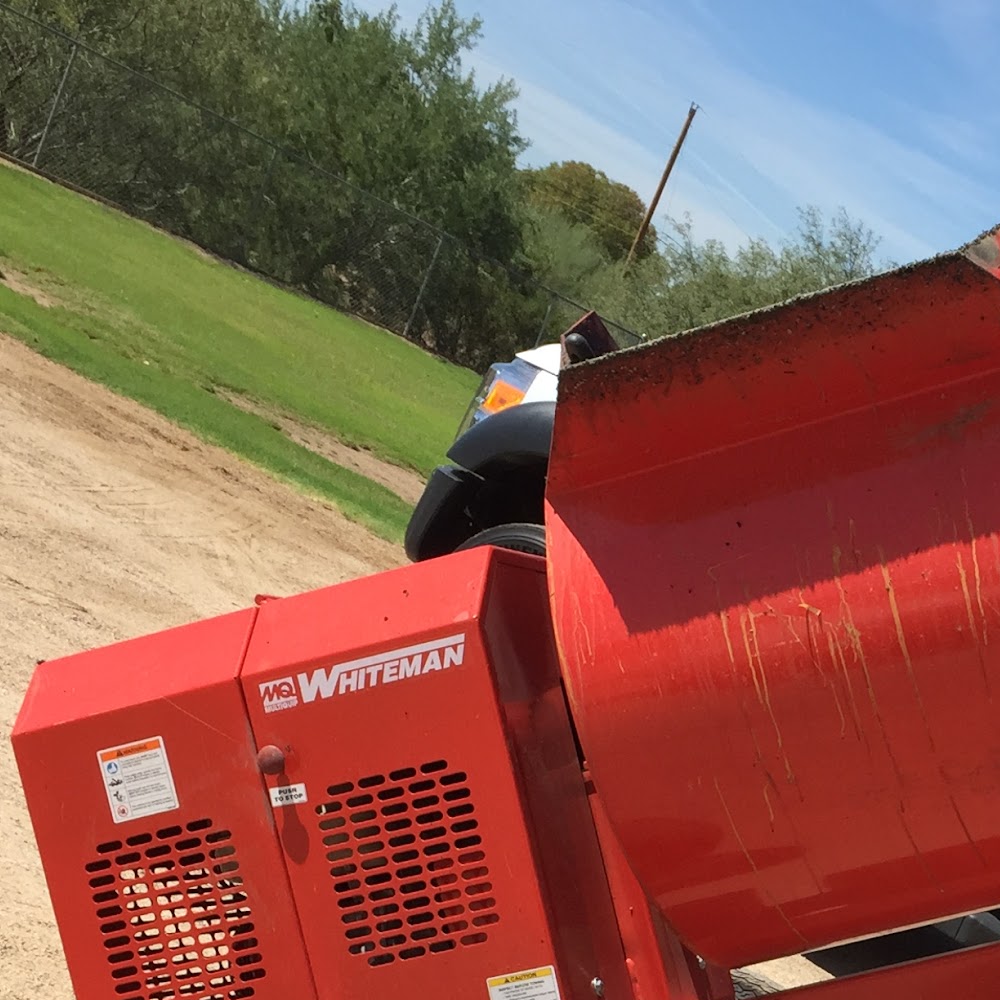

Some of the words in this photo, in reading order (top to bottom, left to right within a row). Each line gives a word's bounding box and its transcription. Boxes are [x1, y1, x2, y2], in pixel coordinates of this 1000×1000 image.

[260, 680, 297, 702] MQ
[297, 633, 466, 704] WHITEMAN
[285, 793, 303, 801] STOP
[510, 972, 537, 982] CAUTION
